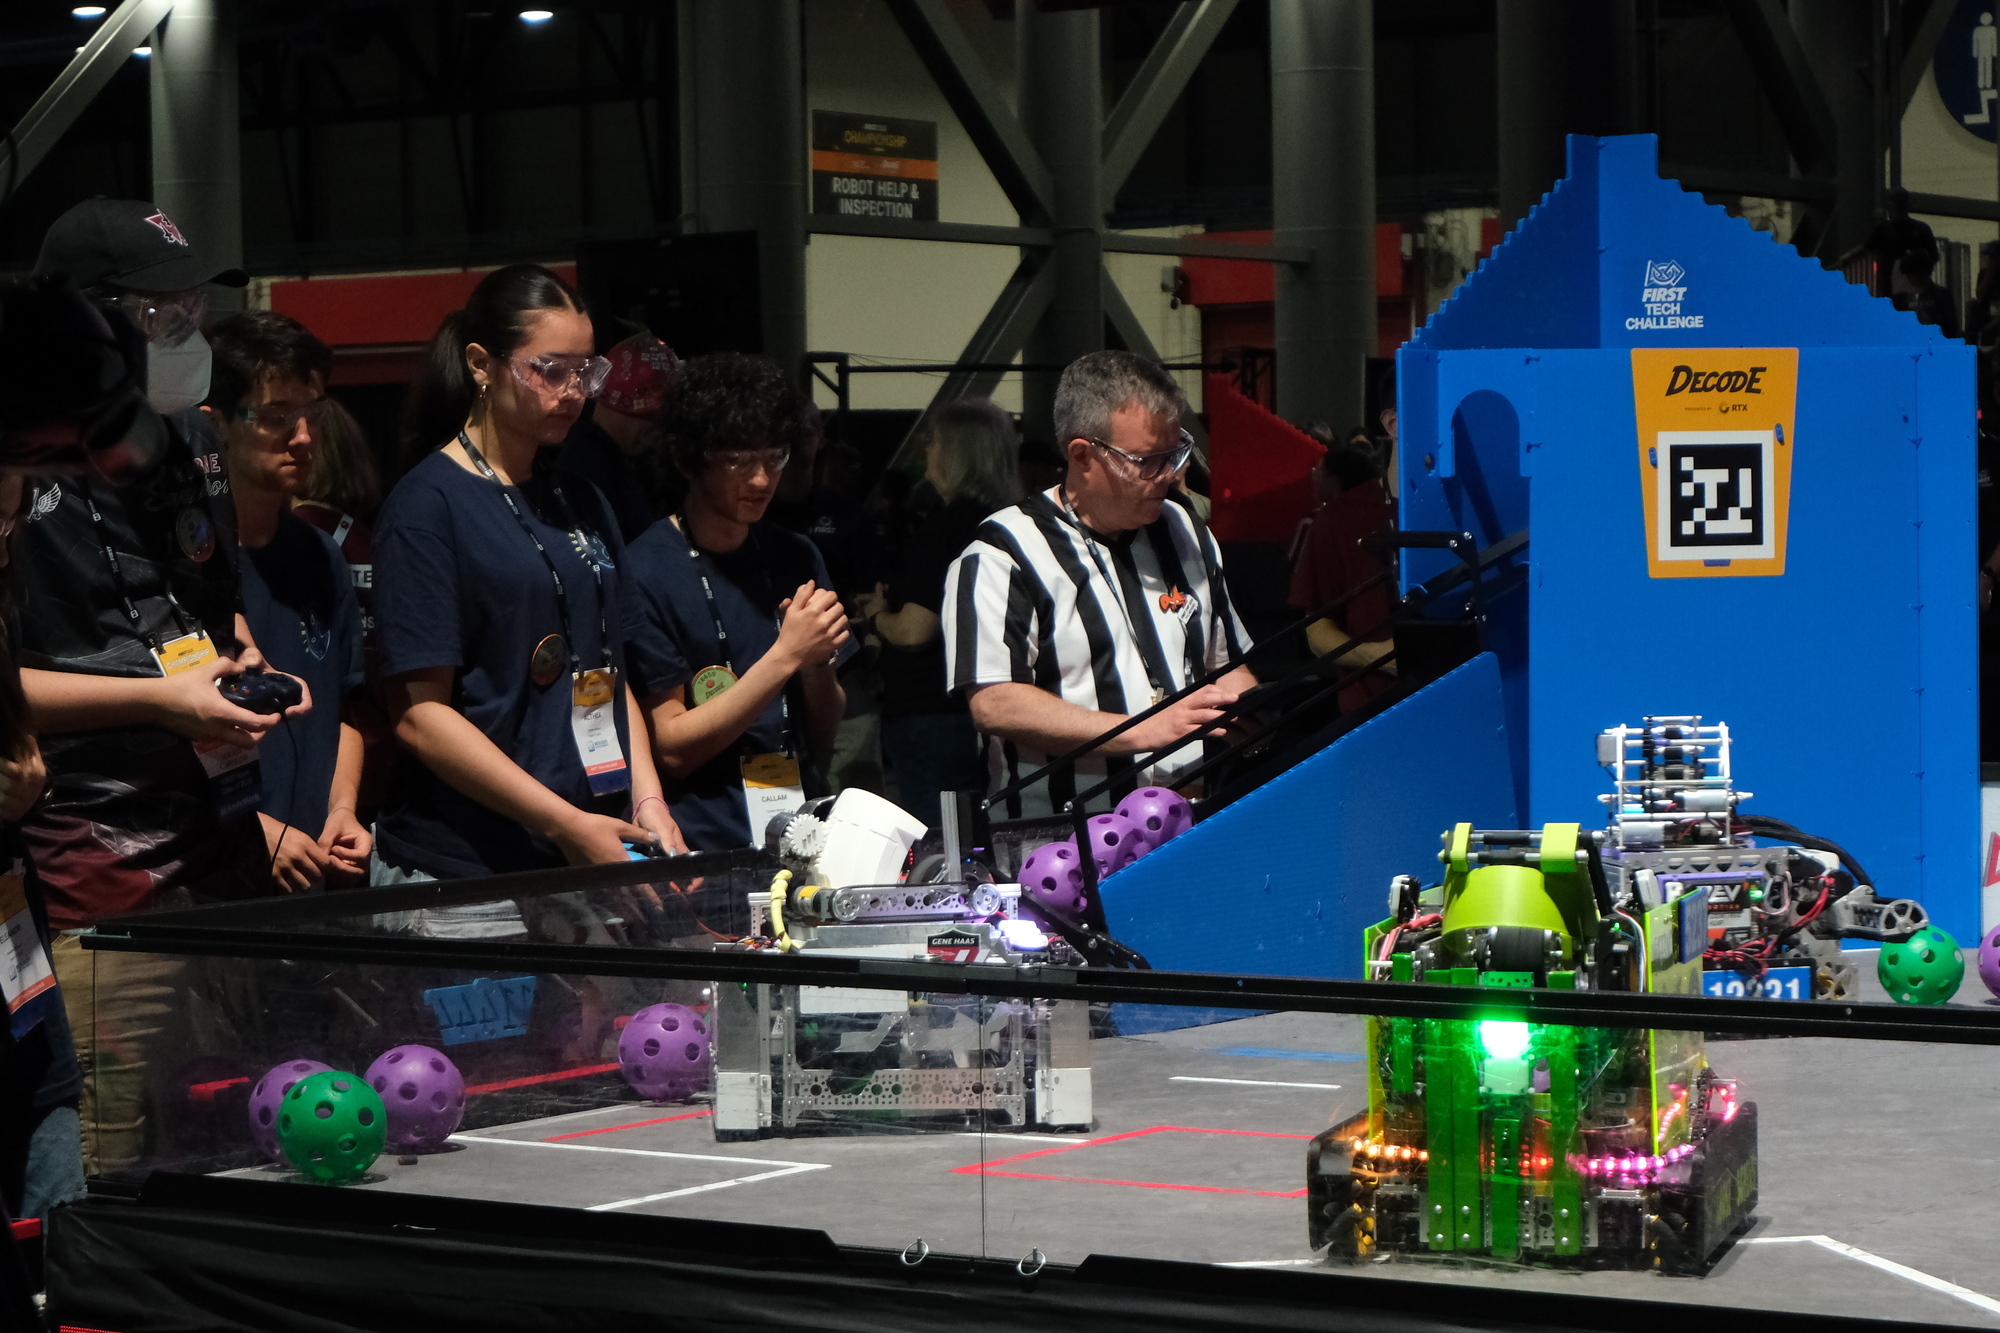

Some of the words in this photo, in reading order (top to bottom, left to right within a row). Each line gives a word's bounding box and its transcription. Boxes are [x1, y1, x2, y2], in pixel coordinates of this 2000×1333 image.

[832, 177, 874, 195] ROBOT
[877, 180, 908, 198] HELP
[909, 183, 920, 200] &
[839, 198, 914, 218] INSPECTION
[1641, 287, 1687, 302] FIRST
[1645, 303, 1681, 315] TECH
[1625, 316, 1704, 330] CHALLENGE
[1665, 365, 1767, 396] DECODE
[1731, 404, 1748, 412] RTX
[761, 794, 788, 803] CALLAM
[932, 937, 953, 945] GENE
[953, 937, 975, 945] HAAS
